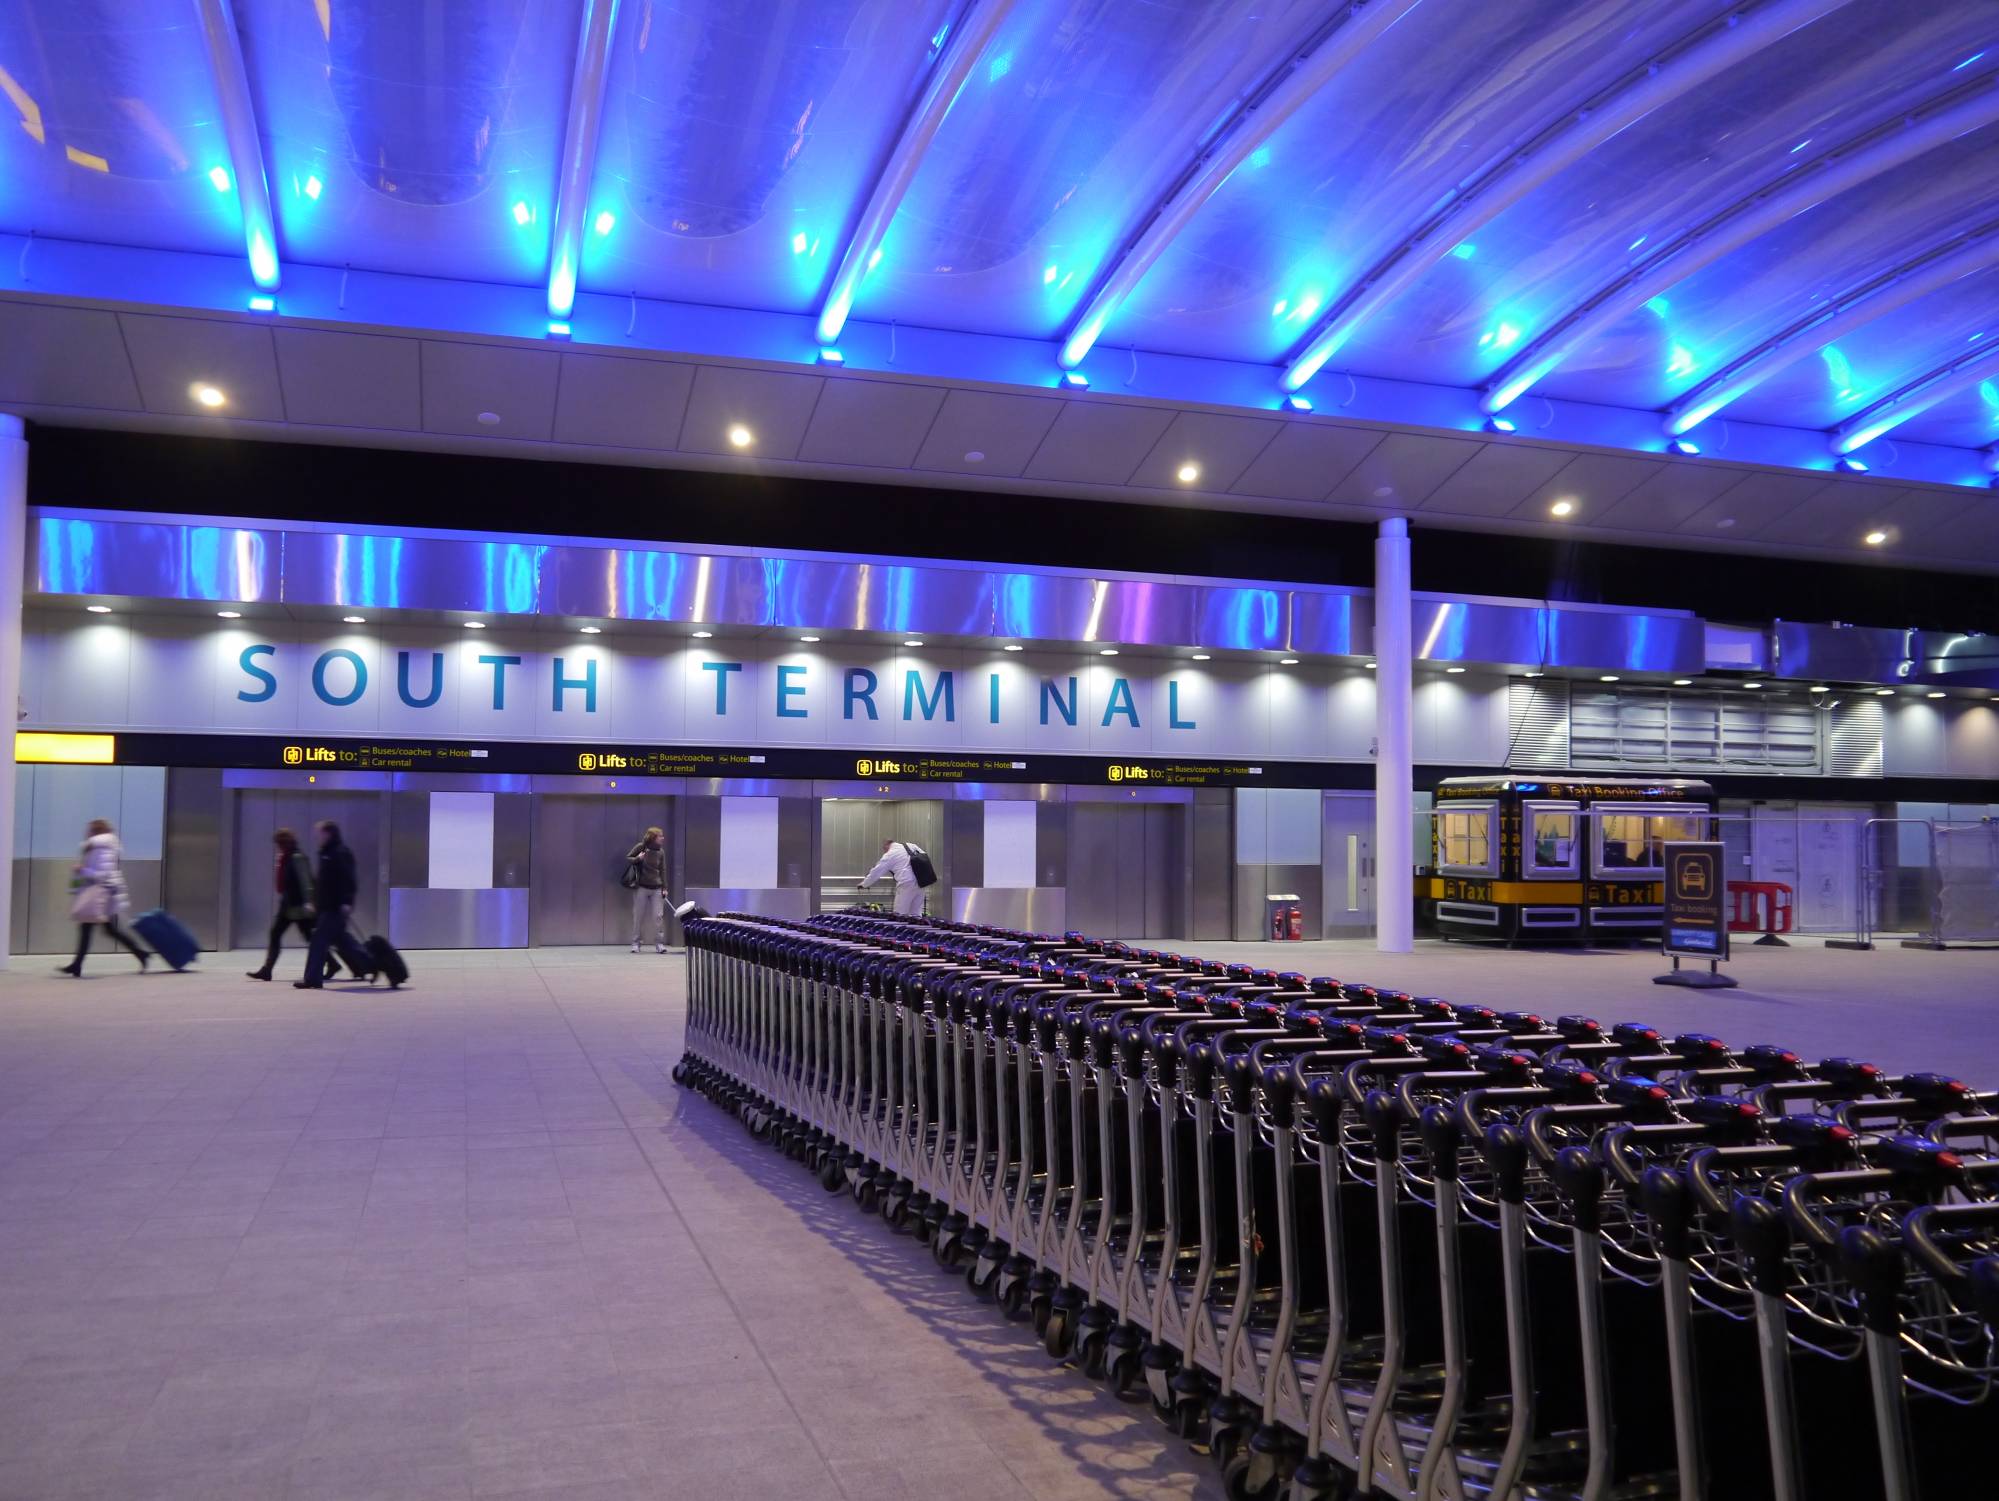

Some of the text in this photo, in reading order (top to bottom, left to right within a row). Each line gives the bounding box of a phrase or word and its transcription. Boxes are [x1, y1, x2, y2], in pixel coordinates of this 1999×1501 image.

[237, 644, 1197, 730] SOUTH TERMINAL
[306, 747, 358, 762] Lifts to:
[372, 747, 432, 757] Buses/coaches
[449, 749, 471, 758] Hotel
[372, 758, 412, 767] Car rental
[599, 754, 647, 768] Lifts to:
[660, 753, 714, 763] Buses/coaches
[730, 755, 750, 763] Hotel
[660, 764, 696, 773] Car rental
[875, 760, 919, 774] Lifts to:
[930, 760, 980, 769] Buses/coaches
[993, 762, 1012, 770] Hotel
[1175, 765, 1220, 774] Buses/coaches
[929, 770, 963, 778] Car rental
[1125, 766, 1165, 779] Lifts to:
[1567, 785, 1592, 797] Taxi
[1595, 786, 1644, 801] Booking
[1500, 816, 1508, 873] Taxi
[1511, 816, 1521, 873] Taxi
[1458, 880, 1492, 902] Taxi
[1605, 884, 1652, 904] Taxi
[1670, 903, 1686, 913] Taxi
